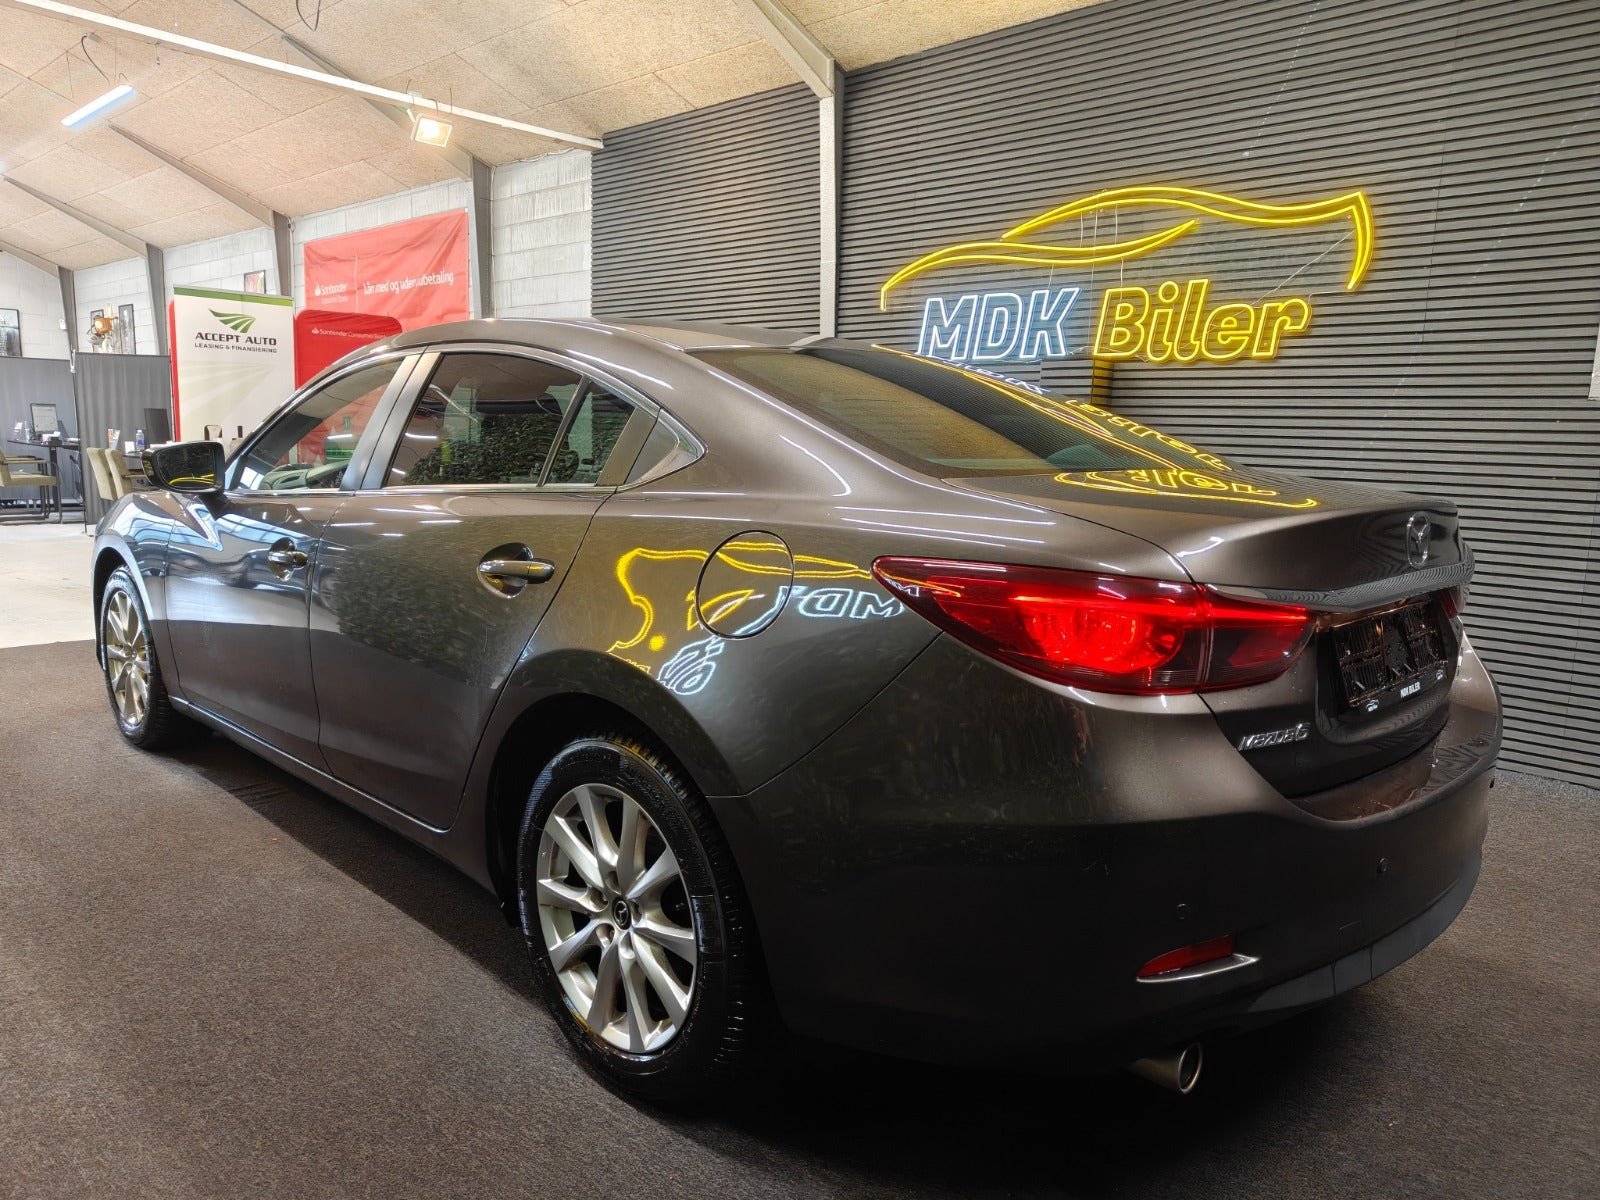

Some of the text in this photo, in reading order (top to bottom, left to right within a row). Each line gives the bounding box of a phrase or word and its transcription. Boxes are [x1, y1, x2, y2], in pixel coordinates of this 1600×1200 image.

[390, 281, 399, 294] og
[915, 278, 1312, 364] MDK Biler
[195, 331, 277, 346] ACCEPT AUTO
[320, 328, 347, 337] Santander
[194, 342, 224, 350] LEASING
[231, 345, 278, 353] FINANSIERING
